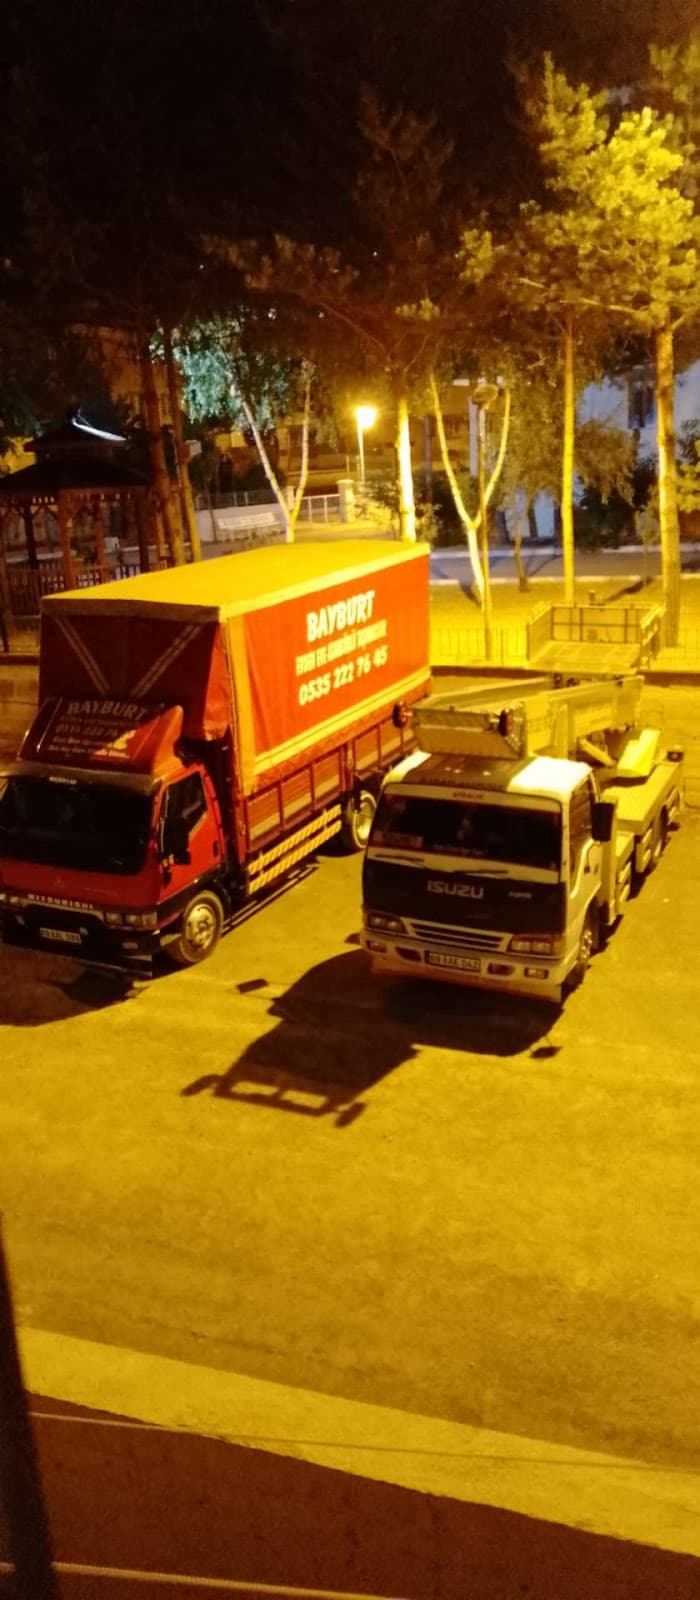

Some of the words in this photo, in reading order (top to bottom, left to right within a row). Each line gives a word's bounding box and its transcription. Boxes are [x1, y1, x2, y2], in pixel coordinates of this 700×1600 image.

[307, 590, 375, 642] BAYBURT
[299, 673, 331, 706] 0535
[333, 662, 354, 688] 222
[67, 701, 148, 721] BAYBURT
[427, 880, 484, 899] ISUZU
[28, 893, 94, 909] MITSUBISHI
